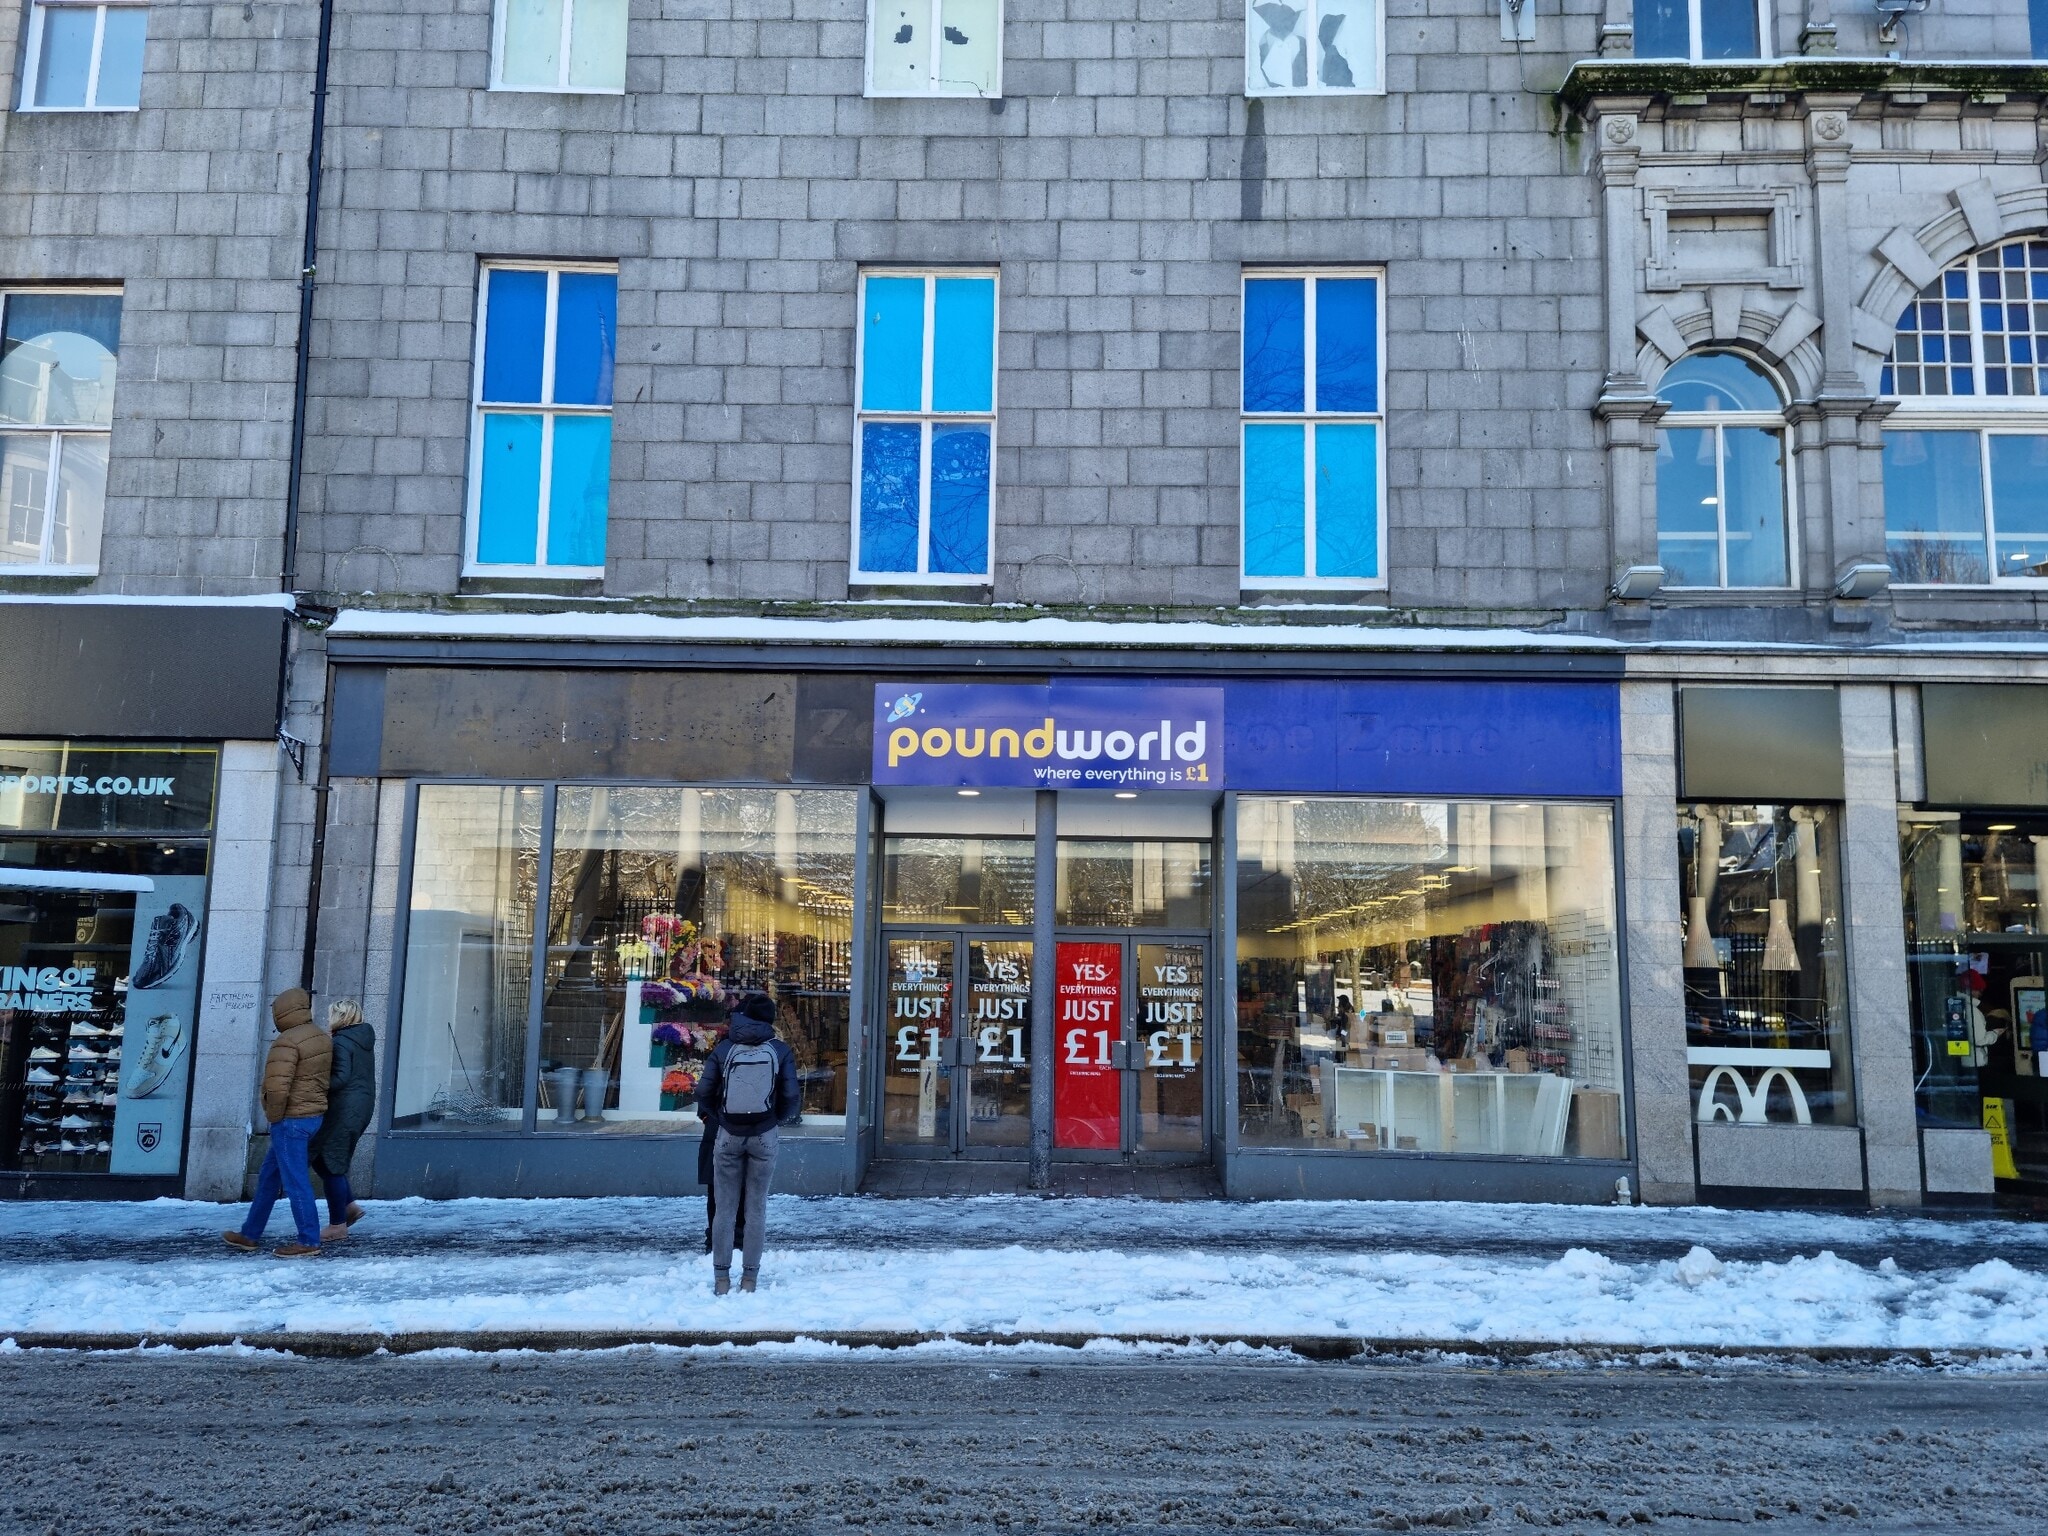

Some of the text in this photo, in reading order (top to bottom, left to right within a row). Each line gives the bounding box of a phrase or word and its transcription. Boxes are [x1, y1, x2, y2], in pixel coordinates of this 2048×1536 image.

[888, 718, 1206, 767] poundworld
[1033, 763, 1209, 784] where everything is £1
[63, 967, 96, 986] OF
[904, 961, 938, 978] YES
[985, 962, 1019, 979] YES
[1072, 963, 1106, 981] YES
[1154, 966, 1188, 983] YES
[892, 982, 949, 992] EVERYTHINGS
[974, 983, 1030, 993] EVERYTHINGS
[1060, 985, 1117, 995] EVERYTHINGS
[1142, 987, 1200, 997] EVERYTHINGS
[894, 997, 945, 1019] JUST
[976, 997, 1028, 1020] JUST
[1062, 999, 1114, 1021] JUST
[1145, 1002, 1197, 1023] JUST
[895, 1025, 942, 1061] £1
[977, 1026, 1026, 1063] £1
[1063, 1028, 1112, 1065] £1
[1147, 1030, 1196, 1067] £1
[143, 1136, 154, 1144] JD
